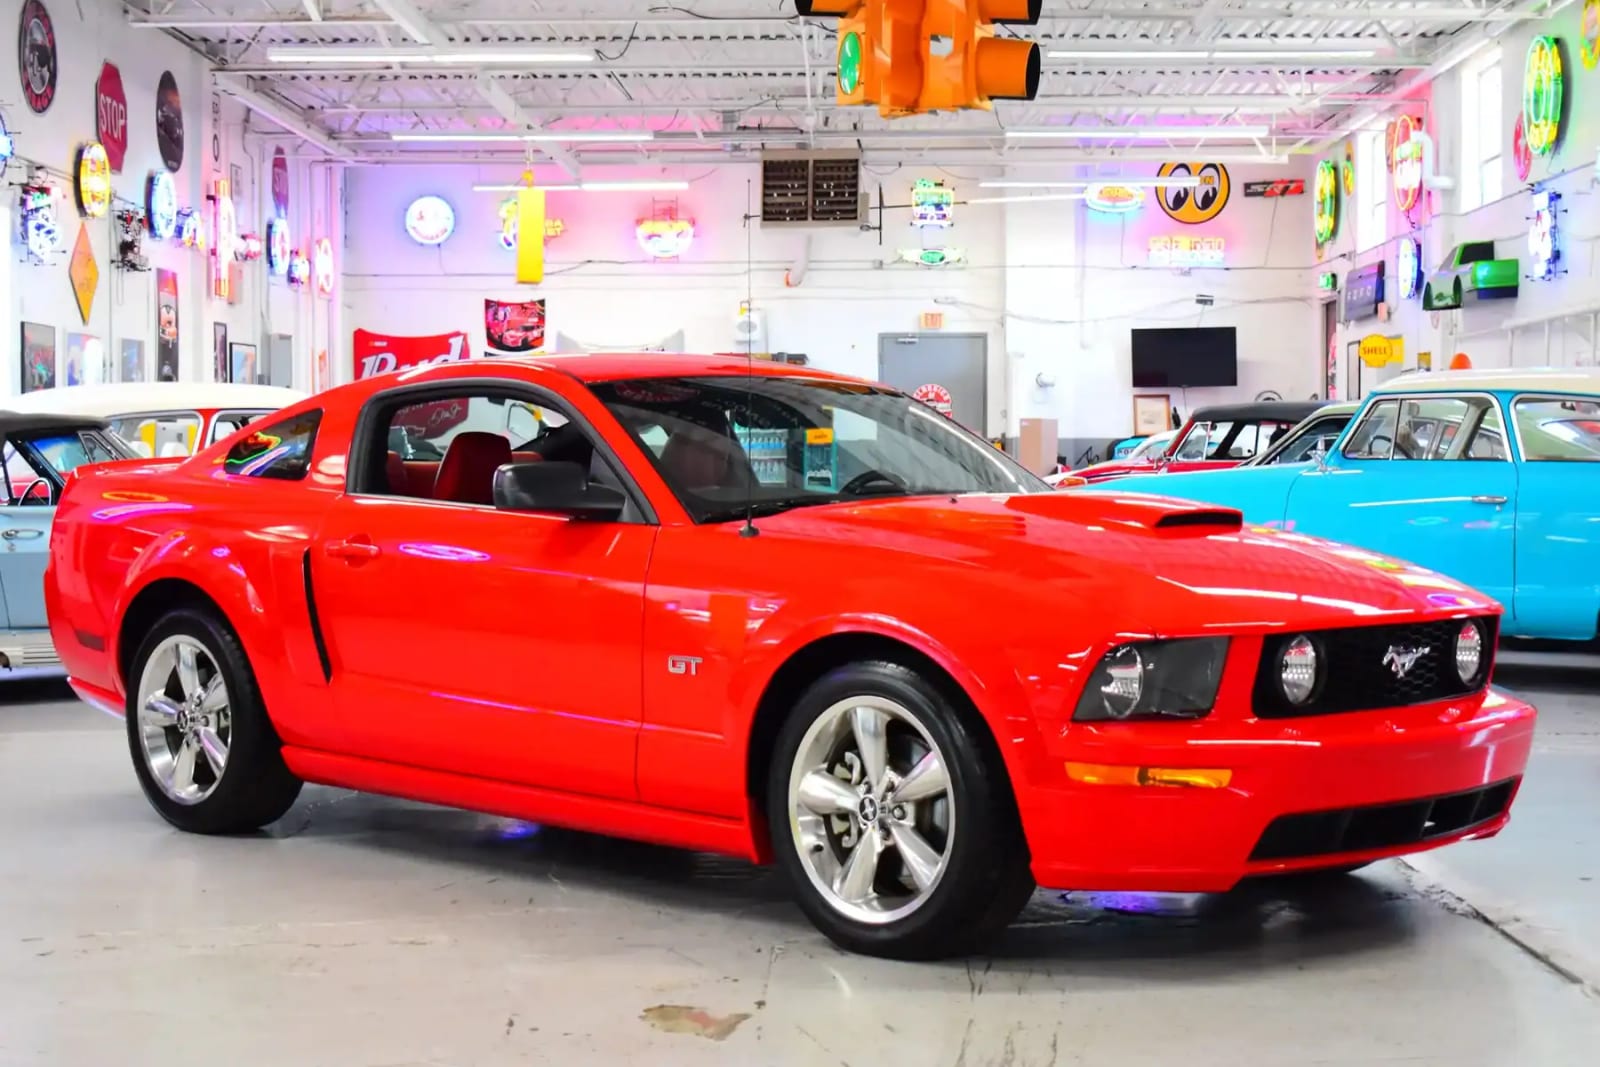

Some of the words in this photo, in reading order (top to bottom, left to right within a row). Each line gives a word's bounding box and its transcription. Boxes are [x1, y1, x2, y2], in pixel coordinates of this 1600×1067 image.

[100, 93, 125, 142] STOP
[1362, 346, 1386, 355] SHELL
[668, 656, 703, 676] GT
